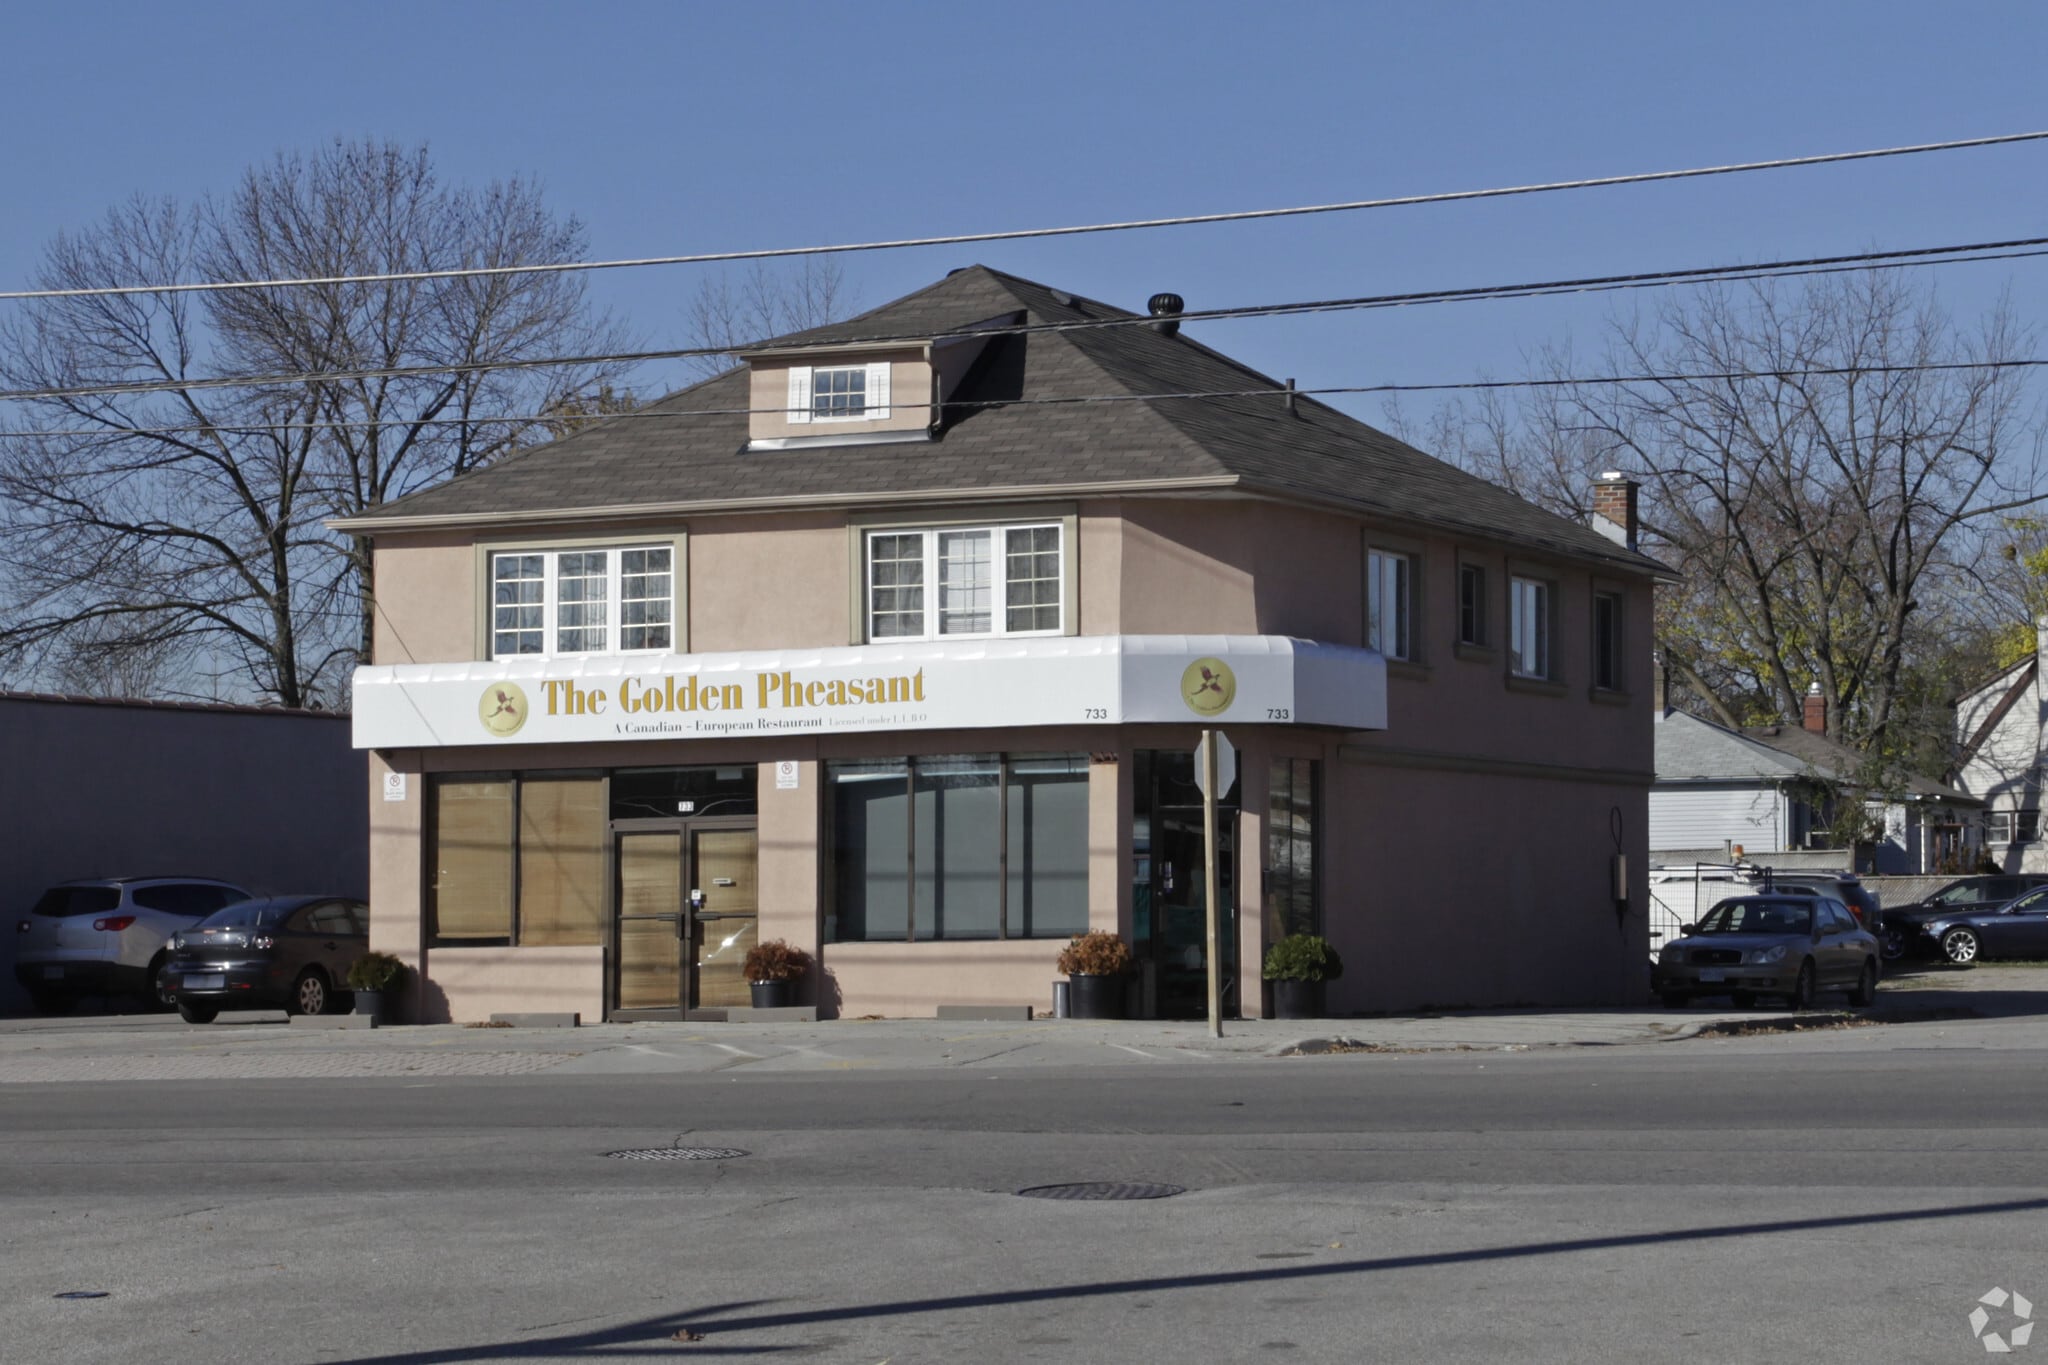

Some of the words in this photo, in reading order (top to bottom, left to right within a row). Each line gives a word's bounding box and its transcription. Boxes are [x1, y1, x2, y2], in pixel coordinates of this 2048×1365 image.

[540, 679, 607, 716] The
[619, 675, 743, 714] Golden
[757, 666, 926, 709] Pheasant
[867, 714, 891, 724] under
[1085, 708, 1107, 719] 733
[1267, 708, 1289, 719] 733
[615, 723, 622, 734] A
[625, 721, 682, 733] Canadian
[696, 719, 754, 734] European
[758, 717, 823, 729] Restaurant
